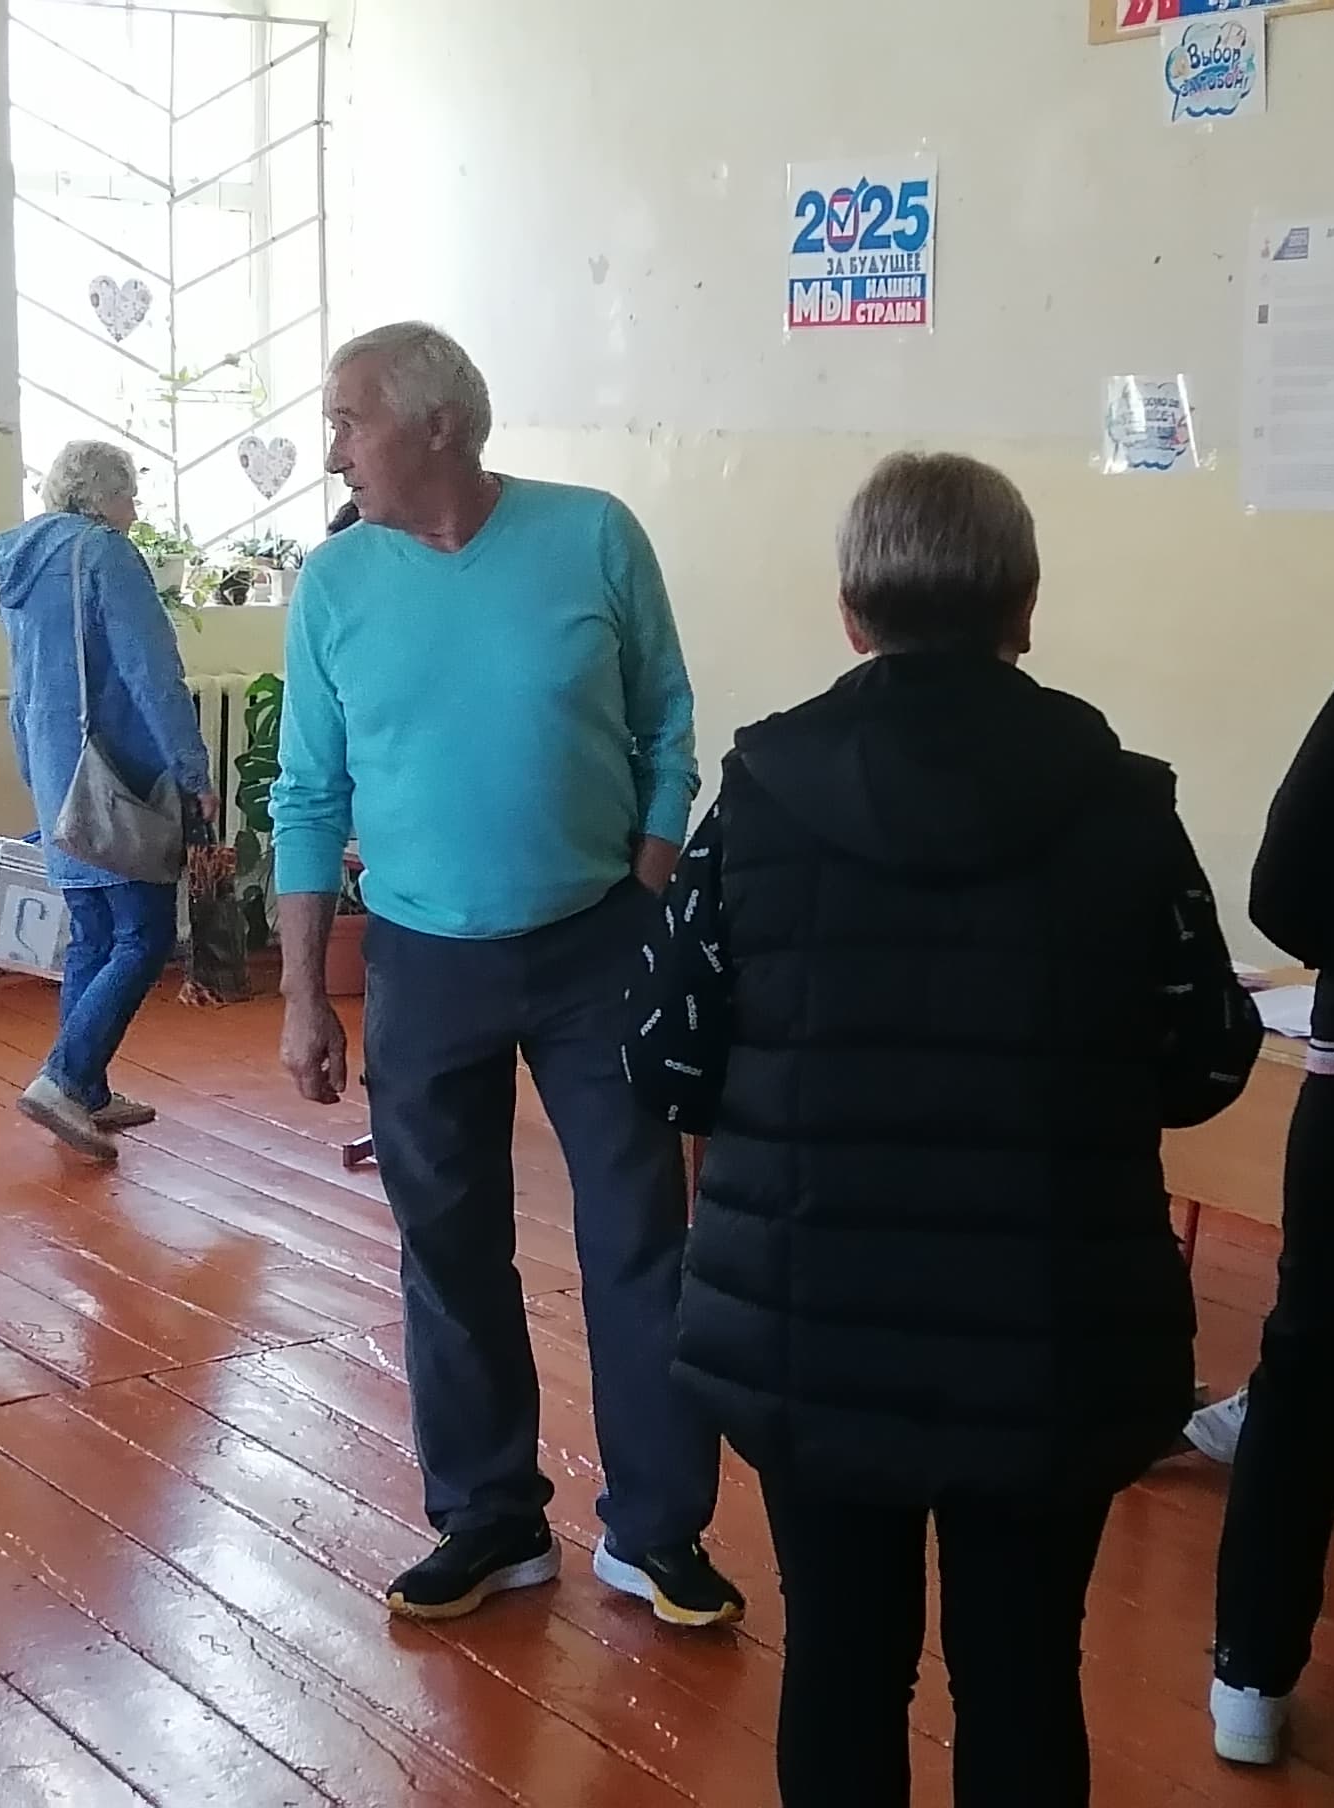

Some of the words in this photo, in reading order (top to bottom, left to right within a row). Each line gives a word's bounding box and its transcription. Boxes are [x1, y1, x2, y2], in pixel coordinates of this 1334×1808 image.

[1187, 35, 1241, 69] Выбор
[792, 180, 929, 254] 2025
[827, 258, 845, 276] ЗА
[850, 253, 921, 275] БУДУЩЕЕ
[793, 279, 853, 323] МЫ
[865, 276, 921, 299] НАШЕЙ
[856, 301, 921, 323] СТРАНЫ
